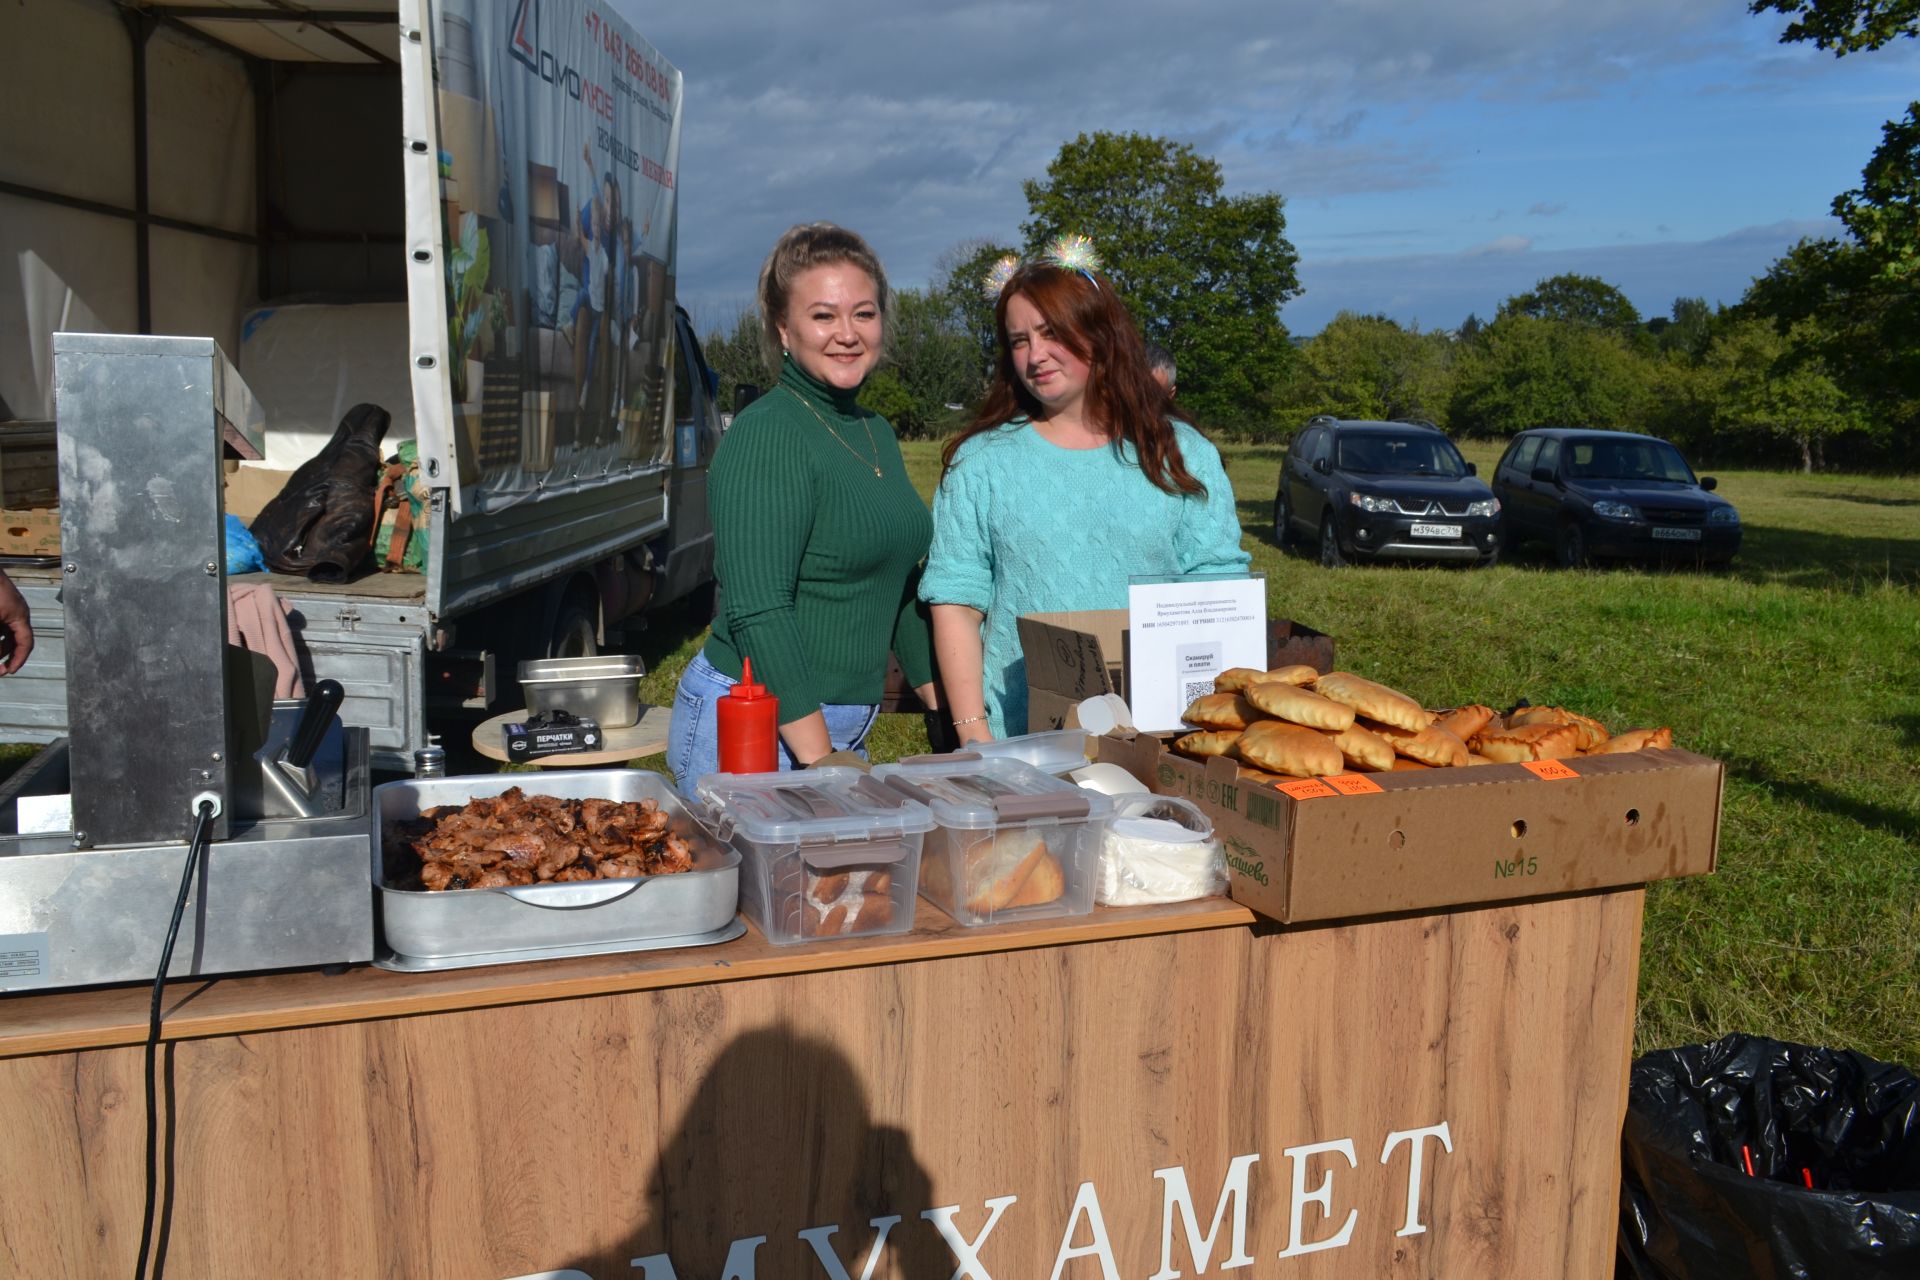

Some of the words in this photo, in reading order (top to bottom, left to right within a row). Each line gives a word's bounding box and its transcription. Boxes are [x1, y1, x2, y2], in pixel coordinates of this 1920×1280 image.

[1185, 653, 1214, 661] Сканируй
[536, 733, 573, 743] ПЕРЧАТКИ
[1223, 843, 1269, 887] кашево
